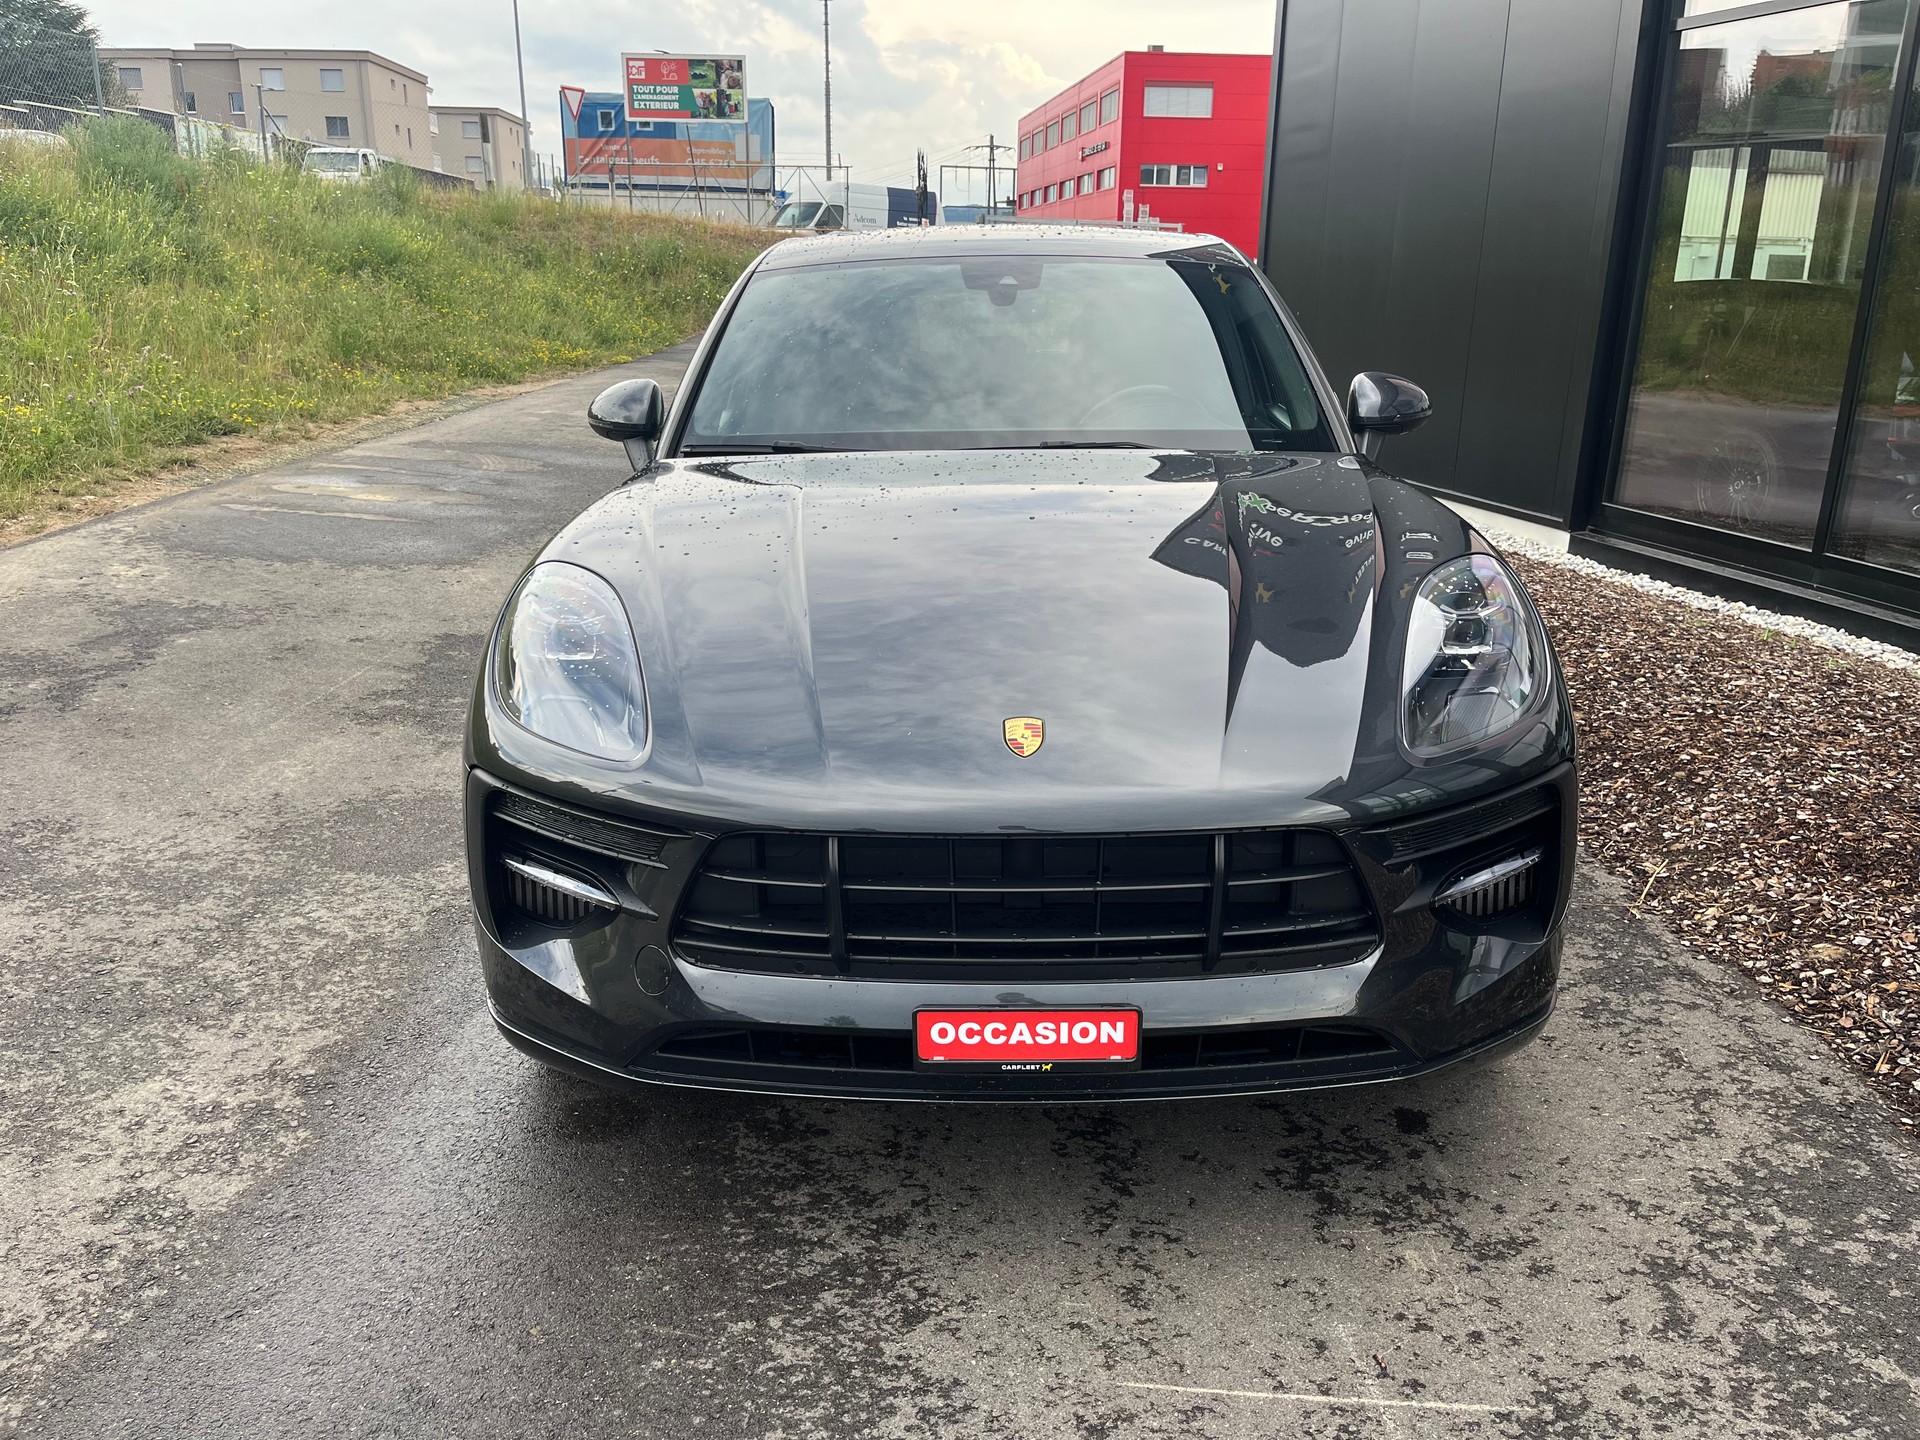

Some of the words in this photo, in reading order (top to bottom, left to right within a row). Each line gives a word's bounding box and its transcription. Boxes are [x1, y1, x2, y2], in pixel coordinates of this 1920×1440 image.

[632, 85, 655, 94] TOUT
[656, 86, 679, 94] POUR
[634, 101, 680, 110] EXTERIEUR
[853, 213, 877, 225] Adcom
[930, 1021, 1125, 1045] OCCASION
[1001, 1063, 1041, 1071] CARFLEET
